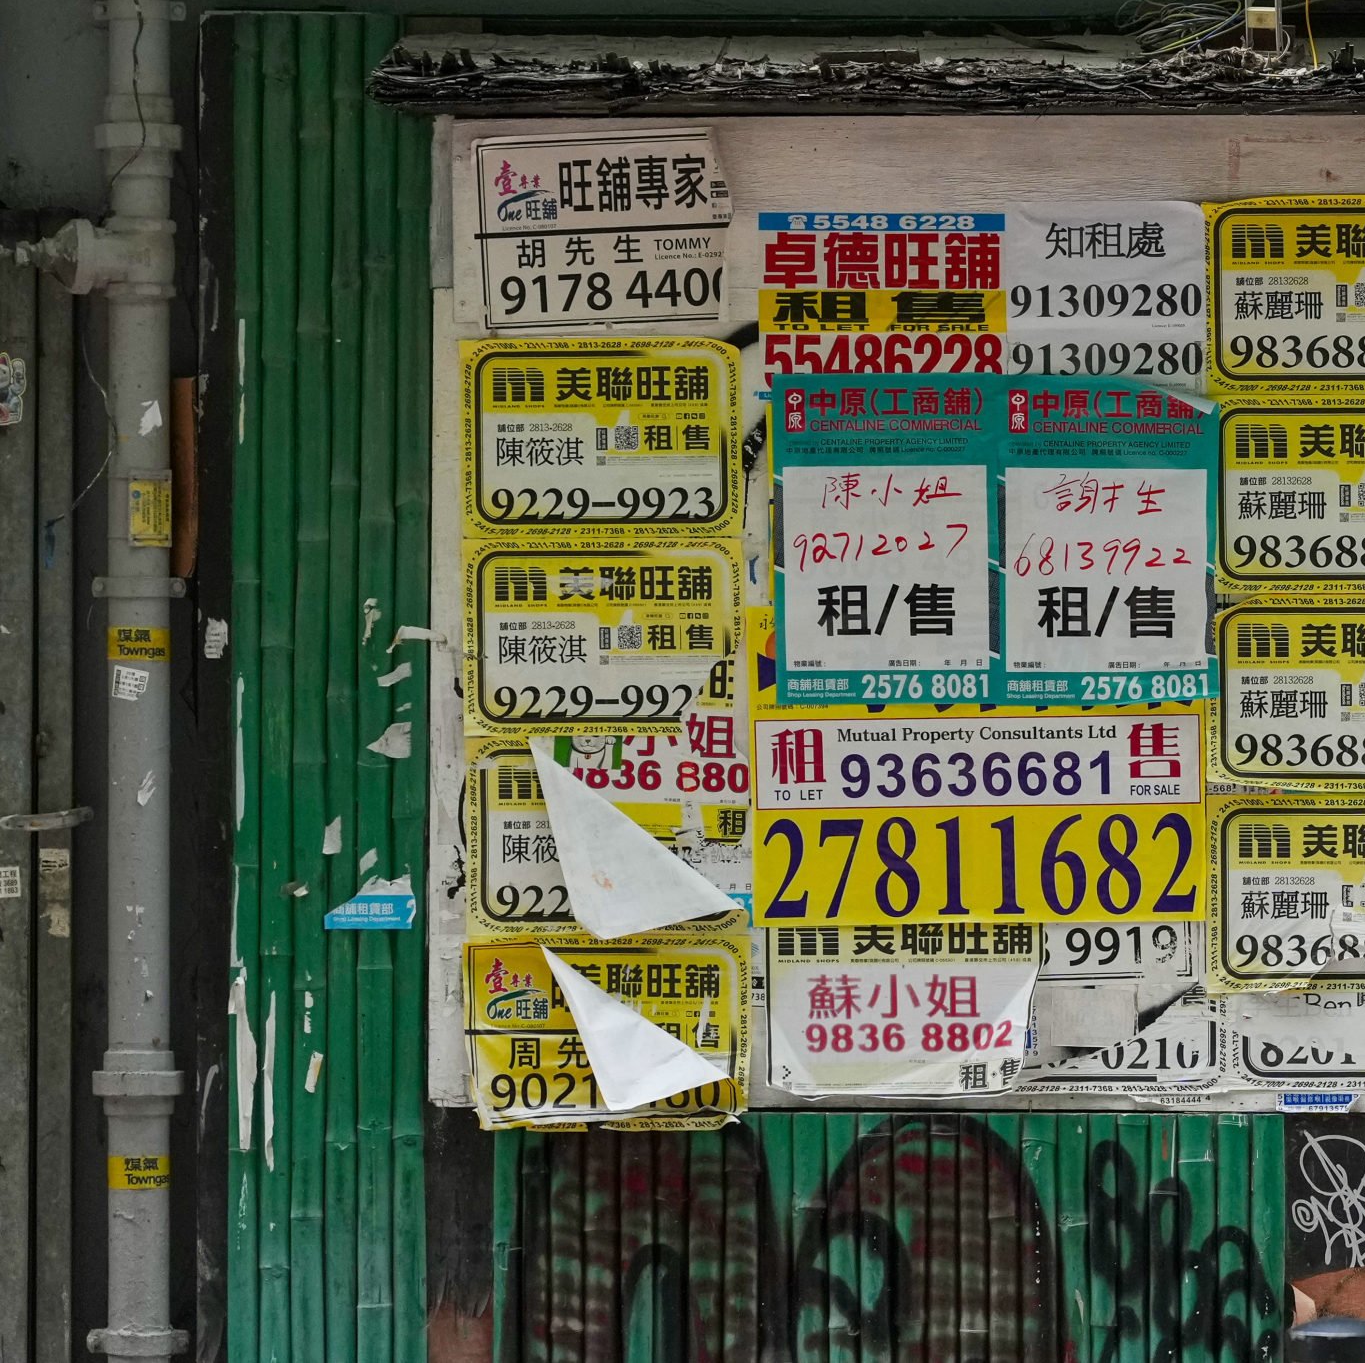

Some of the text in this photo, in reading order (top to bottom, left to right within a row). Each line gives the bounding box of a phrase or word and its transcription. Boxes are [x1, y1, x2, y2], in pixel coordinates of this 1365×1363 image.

[494, 160, 518, 196] 壹
[558, 153, 708, 212] 旺舖專家
[497, 198, 558, 222] One 旺舖
[812, 215, 975, 230] 5548 6228
[516, 234, 643, 269] 胡先生
[655, 237, 711, 251] TOMMY
[1045, 222, 1166, 260] 知租處
[763, 232, 1000, 290] 卓德旺舖
[501, 271, 612, 314] 9178
[1268, 276, 1308, 286] 28132628
[773, 292, 986, 323] 租 售
[1010, 283, 1202, 319] 91309280
[1234, 290, 1323, 321] 蘇麗珊
[891, 324, 930, 332] FOR
[764, 333, 1002, 375] 55486228
[1012, 342, 1202, 377] 91309280
[556, 366, 709, 402] 美聯旺舖
[809, 387, 983, 416] 中原(工商舖)
[810, 419, 981, 432] CENTALINE COMMERCIAL
[1033, 422, 1204, 434] CENTALINE COMMERCIAL
[495, 437, 585, 467] 陳筱淇
[1238, 490, 1327, 521] 蘇麗珊
[792, 524, 969, 573] 92712027
[1014, 532, 1191, 577] 68139922
[558, 566, 713, 602] 美聯旺舖
[118, 644, 165, 657] Towngas
[787, 679, 848, 691] 商舖租賃部
[862, 673, 988, 699] 2576 8081
[1081, 674, 1208, 700] 2576 8081
[1239, 690, 1328, 719] 蘇麗珊
[837, 724, 1116, 744] Mutual Property Consultants Ltd
[771, 729, 827, 785] 租
[1127, 723, 1181, 779] 售
[840, 750, 1111, 798] 93636681
[1130, 784, 1180, 795] FOR SALE
[774, 789, 822, 801] TO LET
[763, 812, 1197, 918] 27811682
[1241, 890, 1328, 920] 蘇麗珊
[807, 974, 980, 1019] 蘇小姐
[806, 1020, 1012, 1053] 9836 8802
